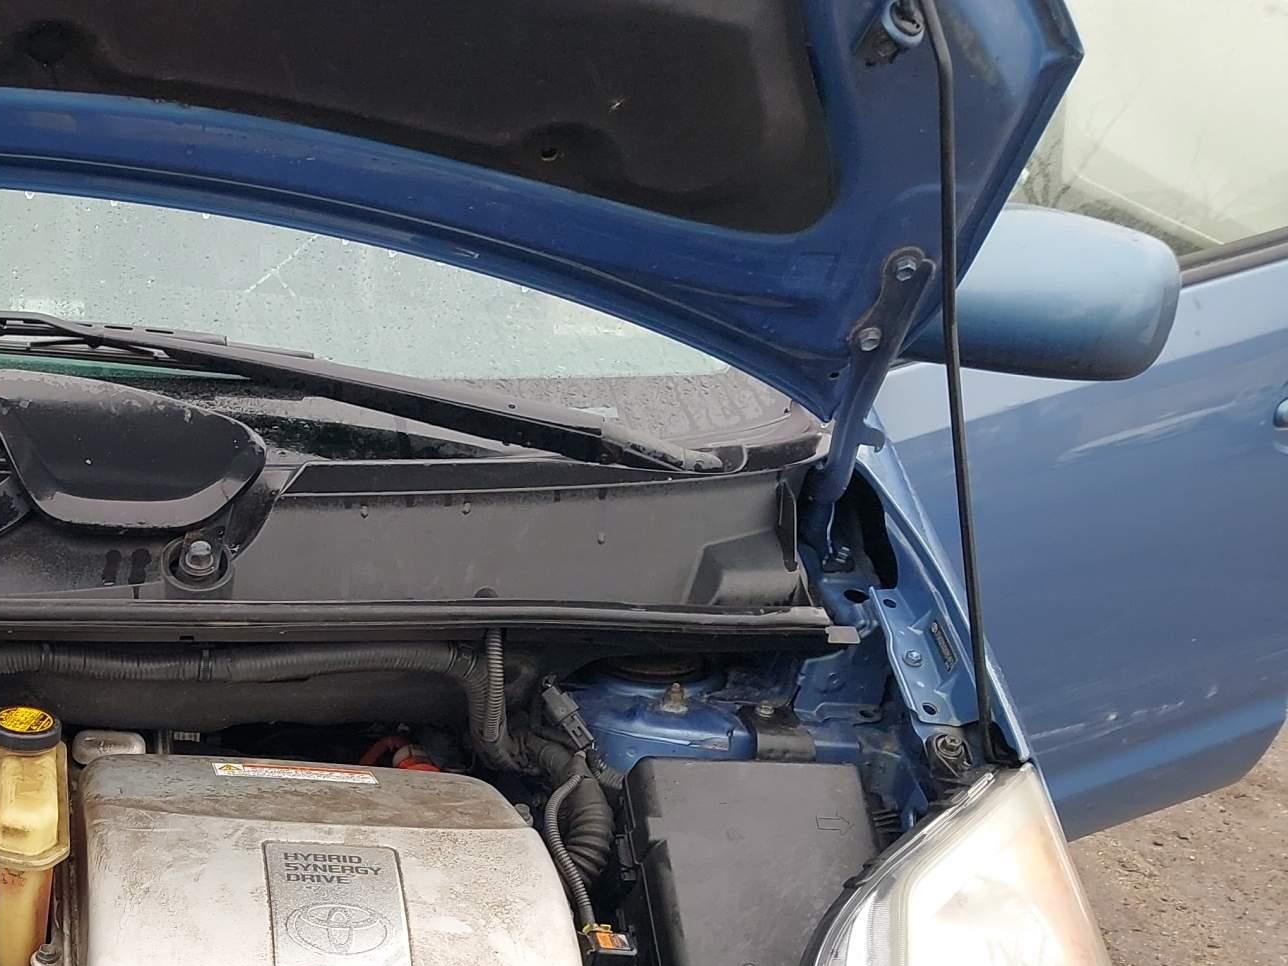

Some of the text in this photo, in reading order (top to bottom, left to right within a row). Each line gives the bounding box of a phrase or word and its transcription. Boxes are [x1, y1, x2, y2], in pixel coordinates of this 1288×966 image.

[283, 852, 362, 864] HYBRID
[284, 862, 382, 876] SYNERGY
[286, 873, 350, 885] DRIVE
